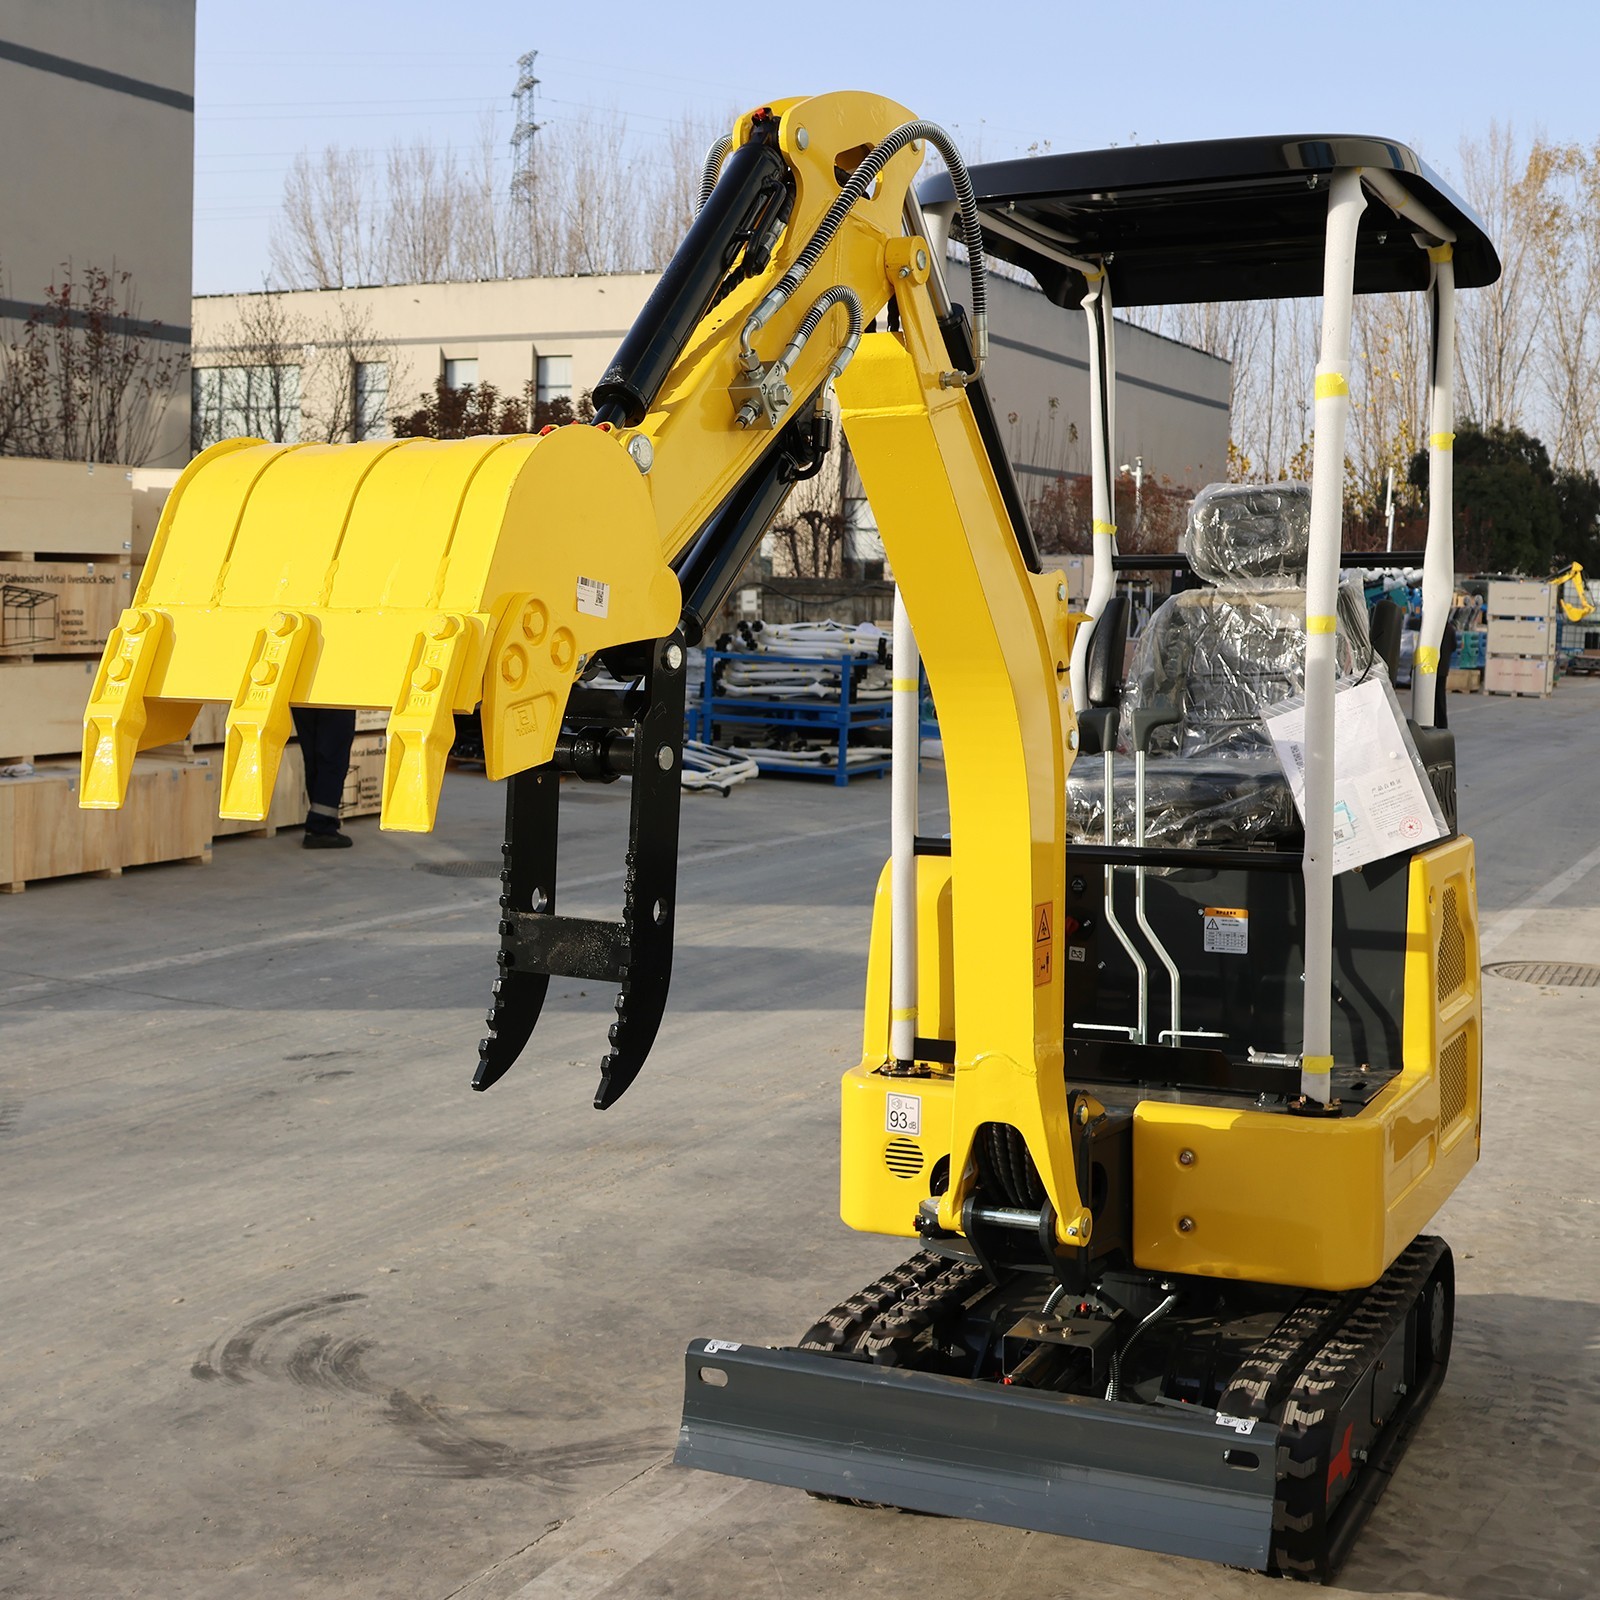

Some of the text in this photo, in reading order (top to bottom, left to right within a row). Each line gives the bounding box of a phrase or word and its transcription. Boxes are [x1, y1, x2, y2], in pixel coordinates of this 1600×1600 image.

[46, 574, 65, 584] Metal
[99, 575, 116, 584] Shed
[890, 1110, 917, 1130] 93 dB
